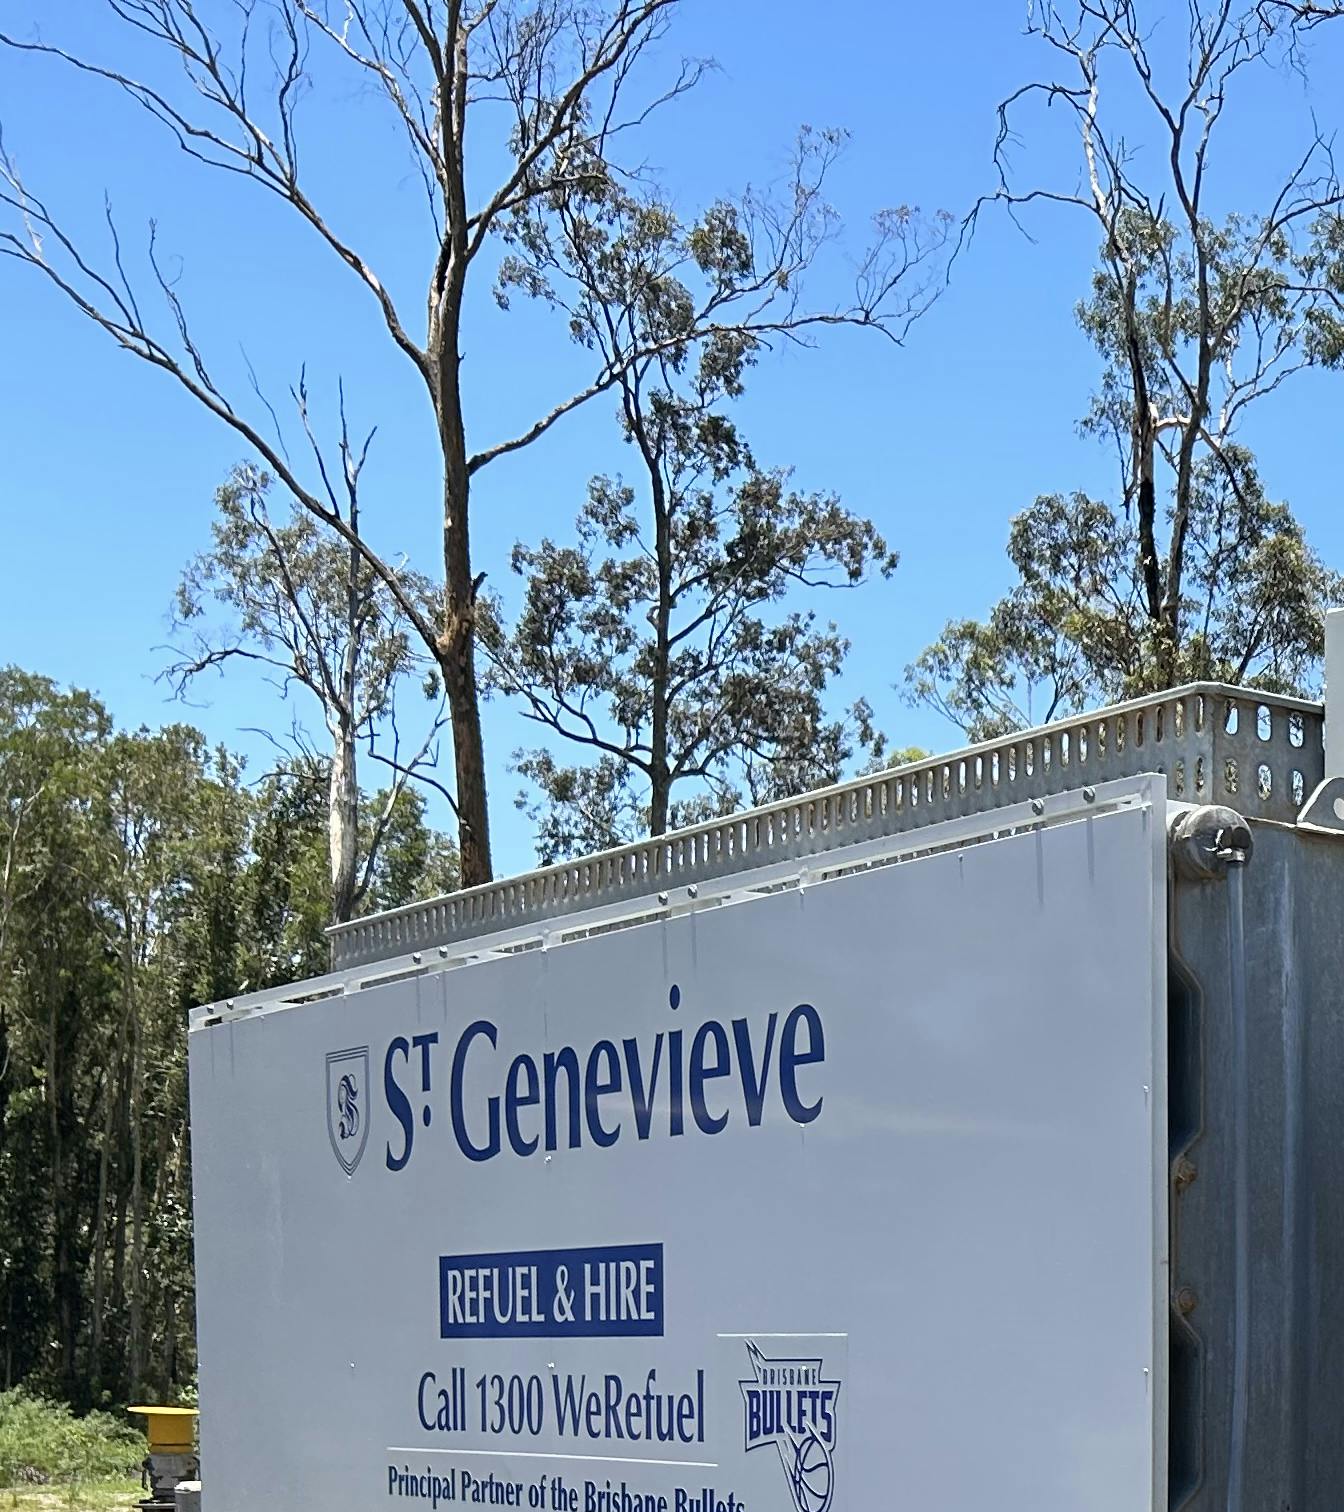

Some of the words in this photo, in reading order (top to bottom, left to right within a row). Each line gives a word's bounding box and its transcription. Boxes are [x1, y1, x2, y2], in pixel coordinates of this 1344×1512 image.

[450, 984, 825, 1162] Genevieve
[447, 1265, 545, 1324] REFUEL
[553, 1264, 575, 1322] &
[584, 1259, 655, 1321] HIRE
[418, 1367, 467, 1432] Call
[476, 1373, 543, 1435] 1300
[551, 1368, 705, 1443] WeRefuel
[746, 1389, 834, 1443] BULLETS
[387, 1465, 456, 1510] Principal
[461, 1470, 522, 1507] Partner
[528, 1475, 547, 1508] of
[551, 1478, 579, 1512] the
